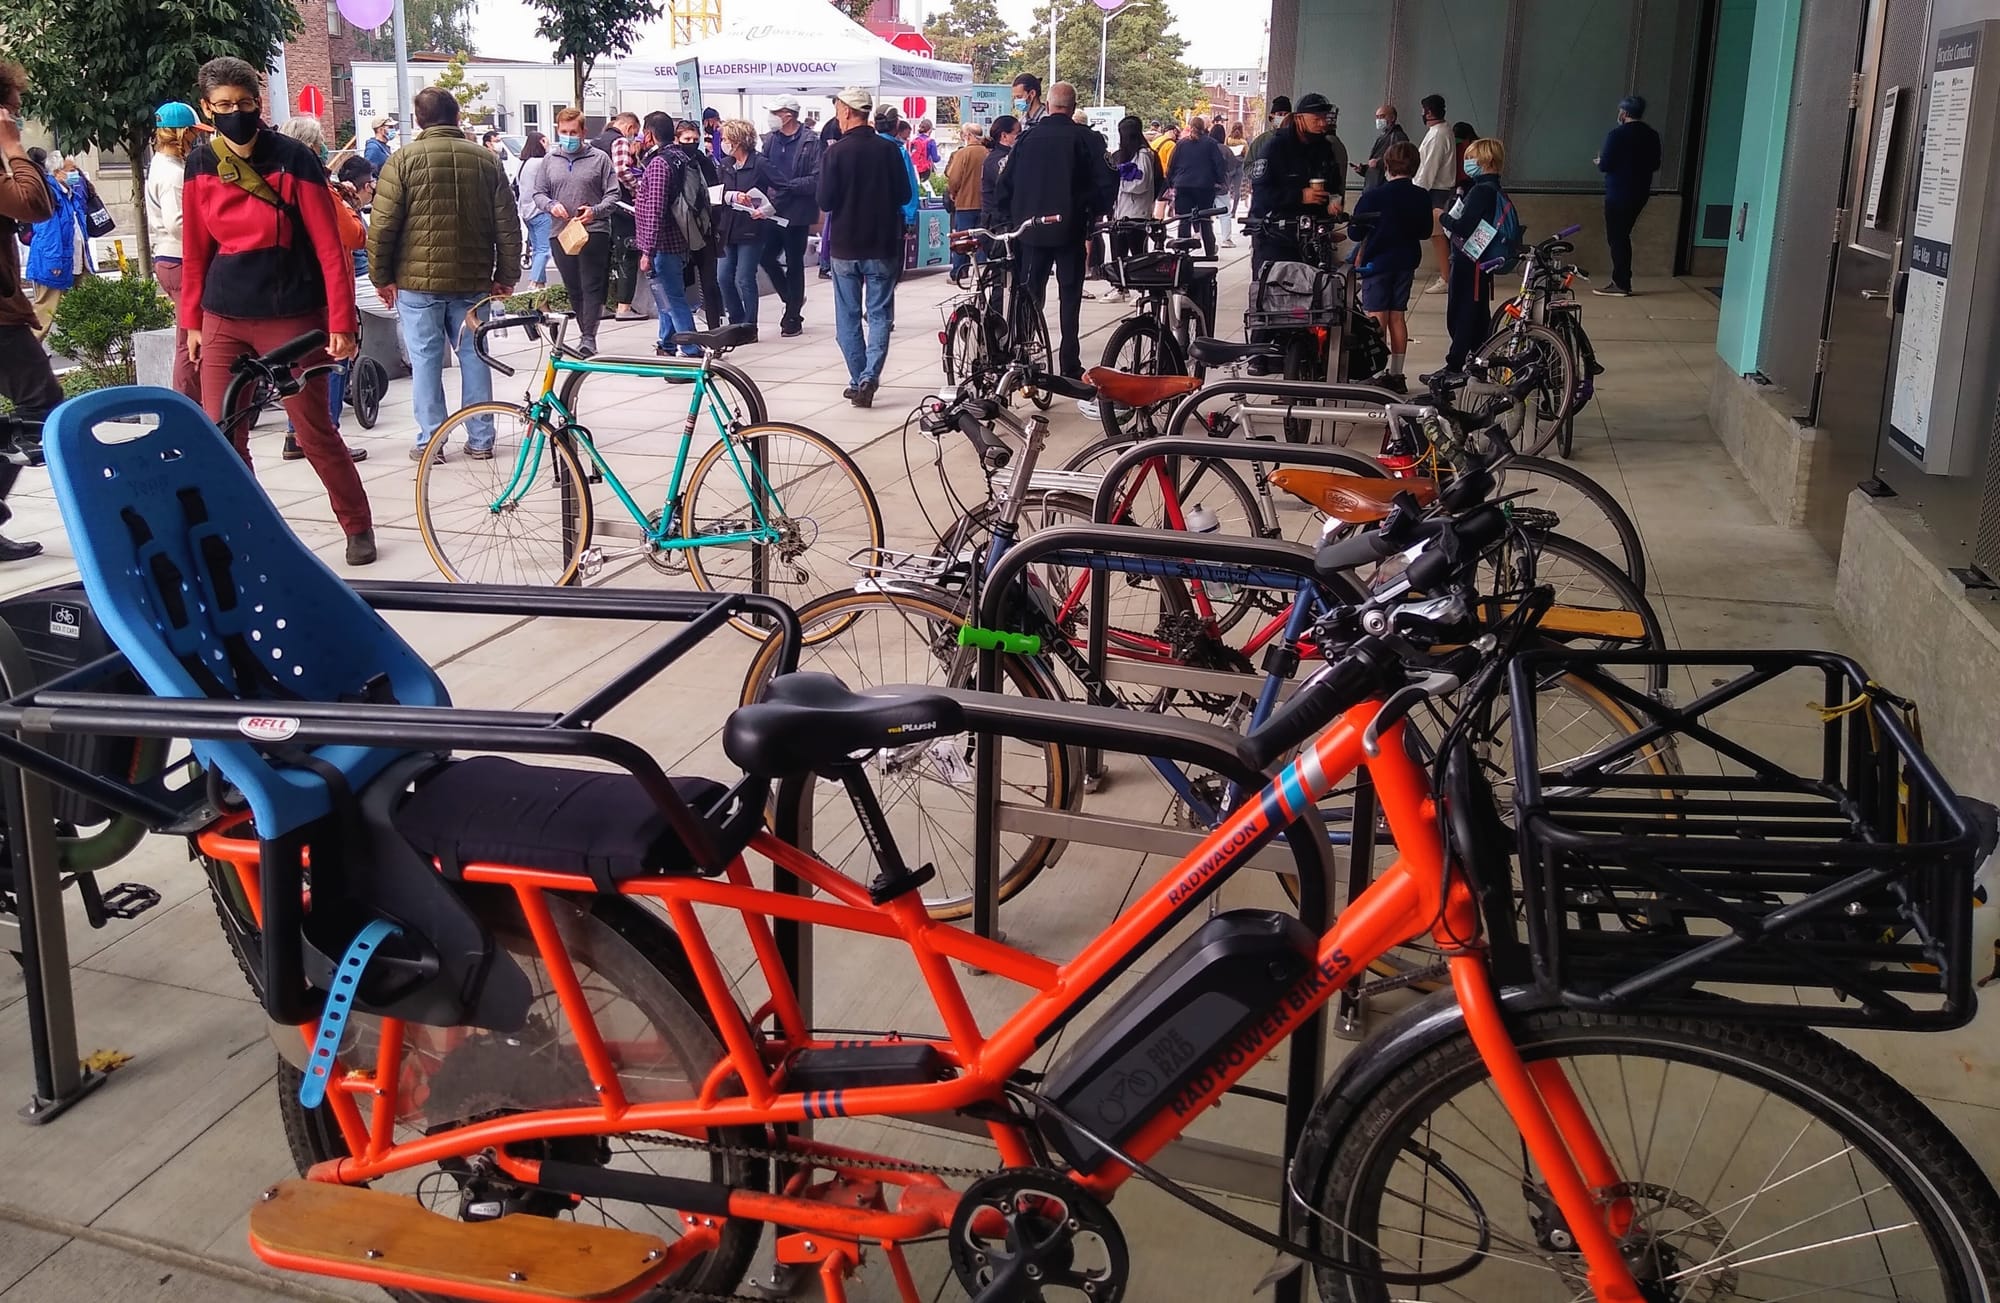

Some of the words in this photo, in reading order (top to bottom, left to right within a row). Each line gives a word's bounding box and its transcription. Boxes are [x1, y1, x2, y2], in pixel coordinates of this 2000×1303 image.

[704, 63, 767, 75] LEADERSHIP
[776, 62, 837, 73] ADVOCACY
[1954, 41, 1973, 60] Conduct
[892, 64, 914, 77] BUILDING
[915, 66, 943, 80] COMMUNITY
[942, 71, 963, 82] TOGETHER
[1042, 622, 1103, 699] SOMA
[902, 721, 936, 732] PLUSH
[853, 796, 883, 852] PROMAX
[1168, 821, 1258, 905] RADWAGON
[1146, 1028, 1183, 1063] RIDE
[1173, 1051, 1221, 1117] RAD
[1215, 1000, 1290, 1080] POWER
[1286, 948, 1351, 1013] BIKES
[1156, 1041, 1195, 1078] RAD
